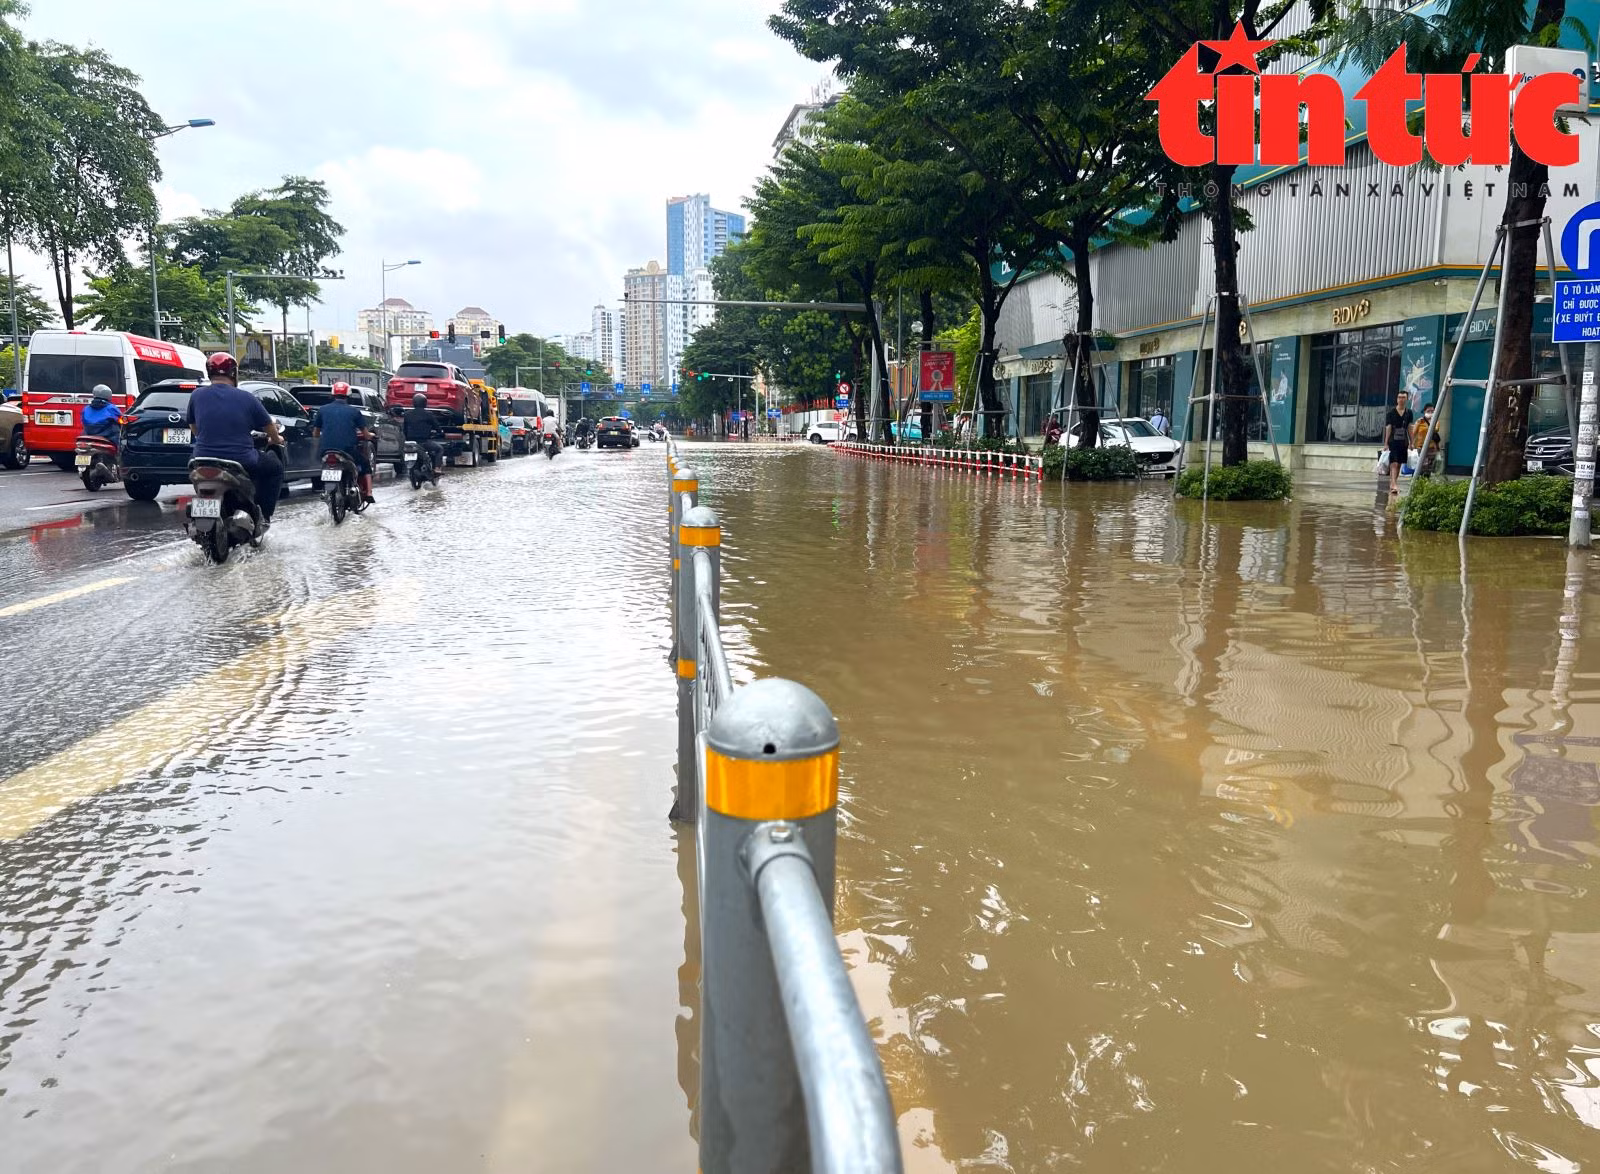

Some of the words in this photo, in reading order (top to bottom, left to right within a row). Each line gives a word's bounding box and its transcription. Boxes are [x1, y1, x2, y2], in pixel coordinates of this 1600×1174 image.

[1563, 284, 1569, 295] Ô
[1572, 284, 1581, 295] TÔ
[1562, 298, 1575, 310] CHỈ
[1579, 299, 1599, 309] ĐƯỢC
[1332, 304, 1359, 325] BIDV
[1574, 310, 1593, 323] BUÝT
[1469, 318, 1491, 333] BIDV
